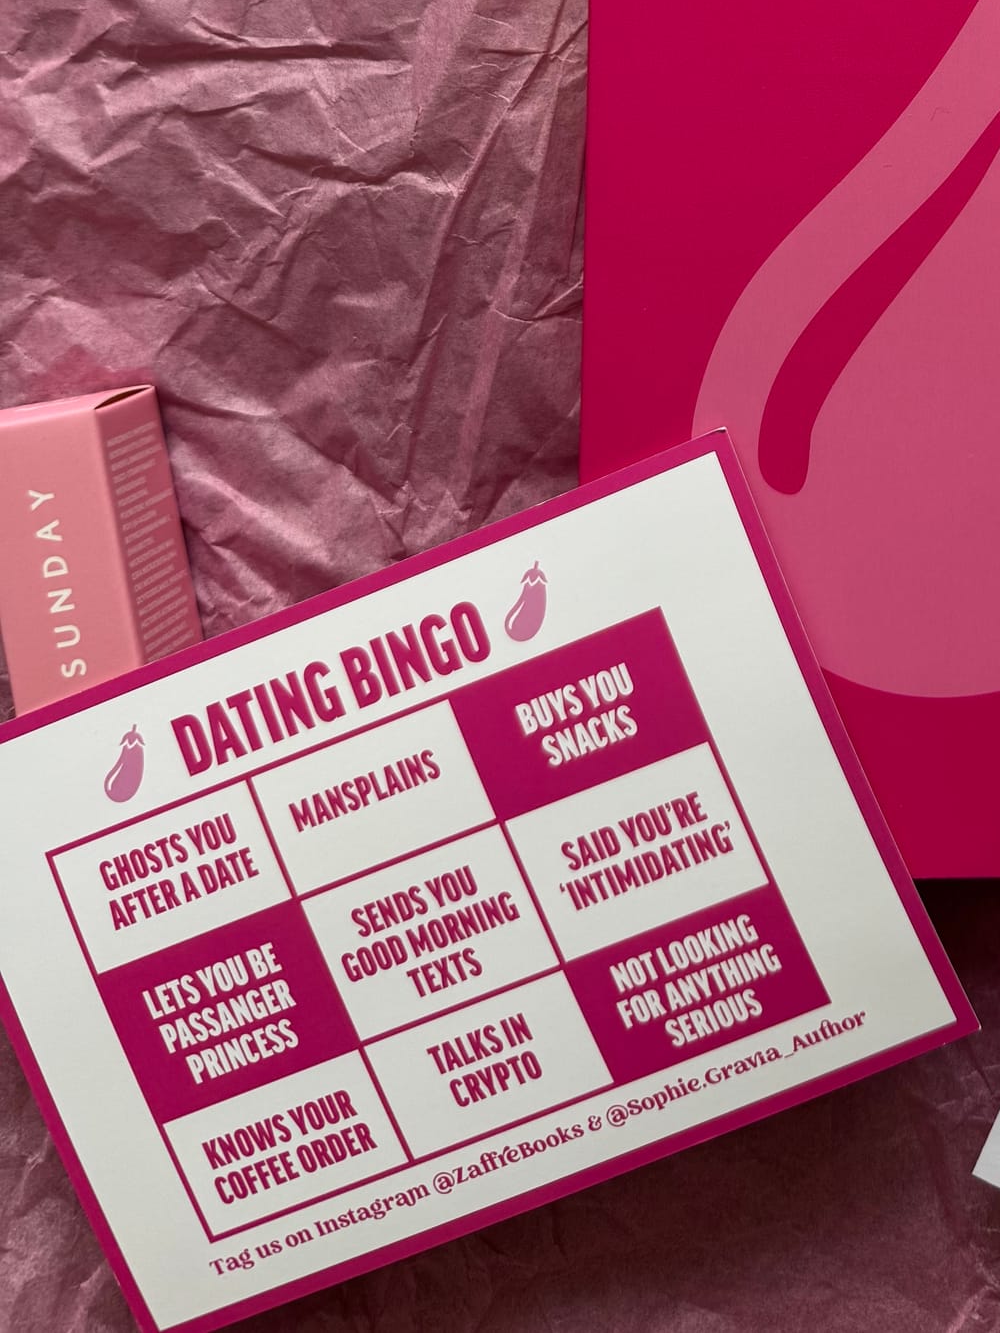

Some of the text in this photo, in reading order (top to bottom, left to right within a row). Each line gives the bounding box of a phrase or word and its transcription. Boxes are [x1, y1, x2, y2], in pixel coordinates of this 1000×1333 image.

[27, 488, 88, 680] SUNDAY
[170, 602, 491, 777] DATING BINGO
[515, 662, 634, 736] BUYS YOU
[541, 705, 638, 767] SNACKS
[288, 750, 440, 832] MANSPLAINS
[99, 813, 237, 891] GHOSTS YOU
[559, 822, 734, 911] 'INTIMIDATING'
[561, 793, 707, 871] SAID YOU'RE
[109, 847, 259, 931] AFTER A DATE
[351, 866, 478, 938] SENDS YOU
[341, 892, 520, 983] GOOD MORNING
[406, 948, 482, 998] TEXTS
[609, 914, 759, 994] NOT LOOKING
[142, 942, 283, 1020] LETS YOU BE
[158, 979, 297, 1054] PASSANGER
[616, 943, 782, 1029] FOR ANYTHING
[664, 988, 763, 1047] SERIOUS
[185, 1018, 299, 1085] PRINCESS
[426, 1013, 533, 1075] TALKS IN
[449, 1051, 542, 1108] CRYPTO
[202, 1090, 357, 1170] KNOWS YOUR
[214, 1123, 377, 1205] COFFEE ORDER
[208, 1248, 256, 1276] Tag
[254, 1239, 284, 1259] us
[284, 1228, 315, 1248] on
[313, 1184, 432, 1237] Instagram
[587, 1115, 603, 1132] &
